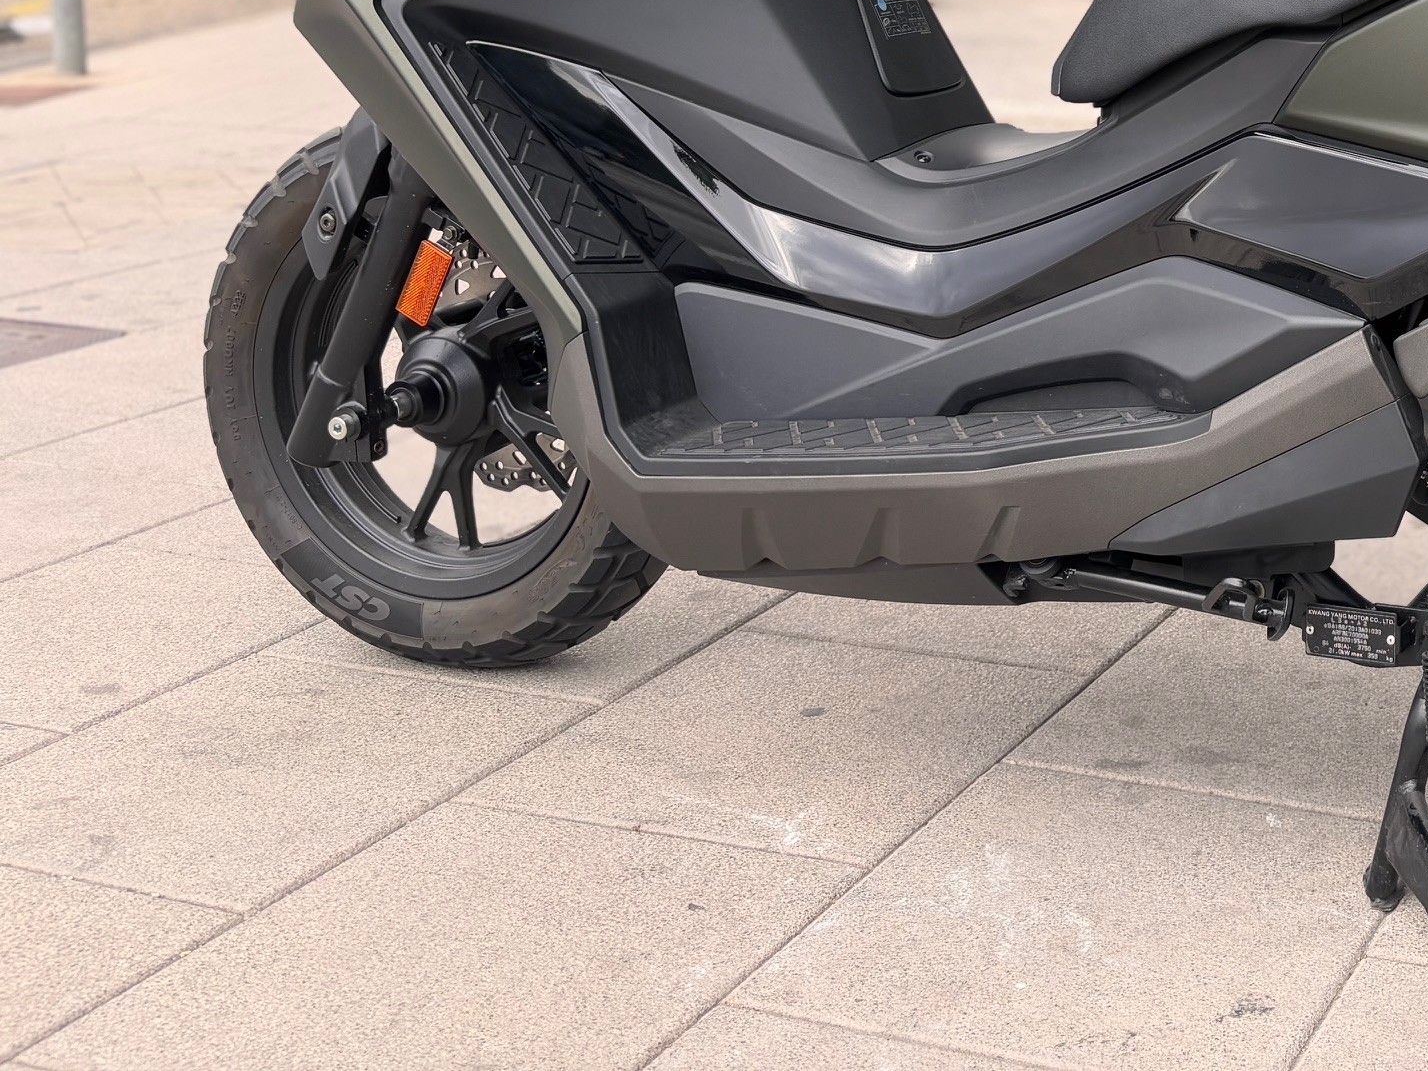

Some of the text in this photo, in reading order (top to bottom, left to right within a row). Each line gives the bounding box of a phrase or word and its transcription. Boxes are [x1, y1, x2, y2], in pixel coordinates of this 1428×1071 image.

[310, 573, 391, 621] CST
[1308, 609, 1330, 617] KWANG
[1331, 611, 1347, 619] YANG
[1348, 614, 1369, 622] MOTOR
